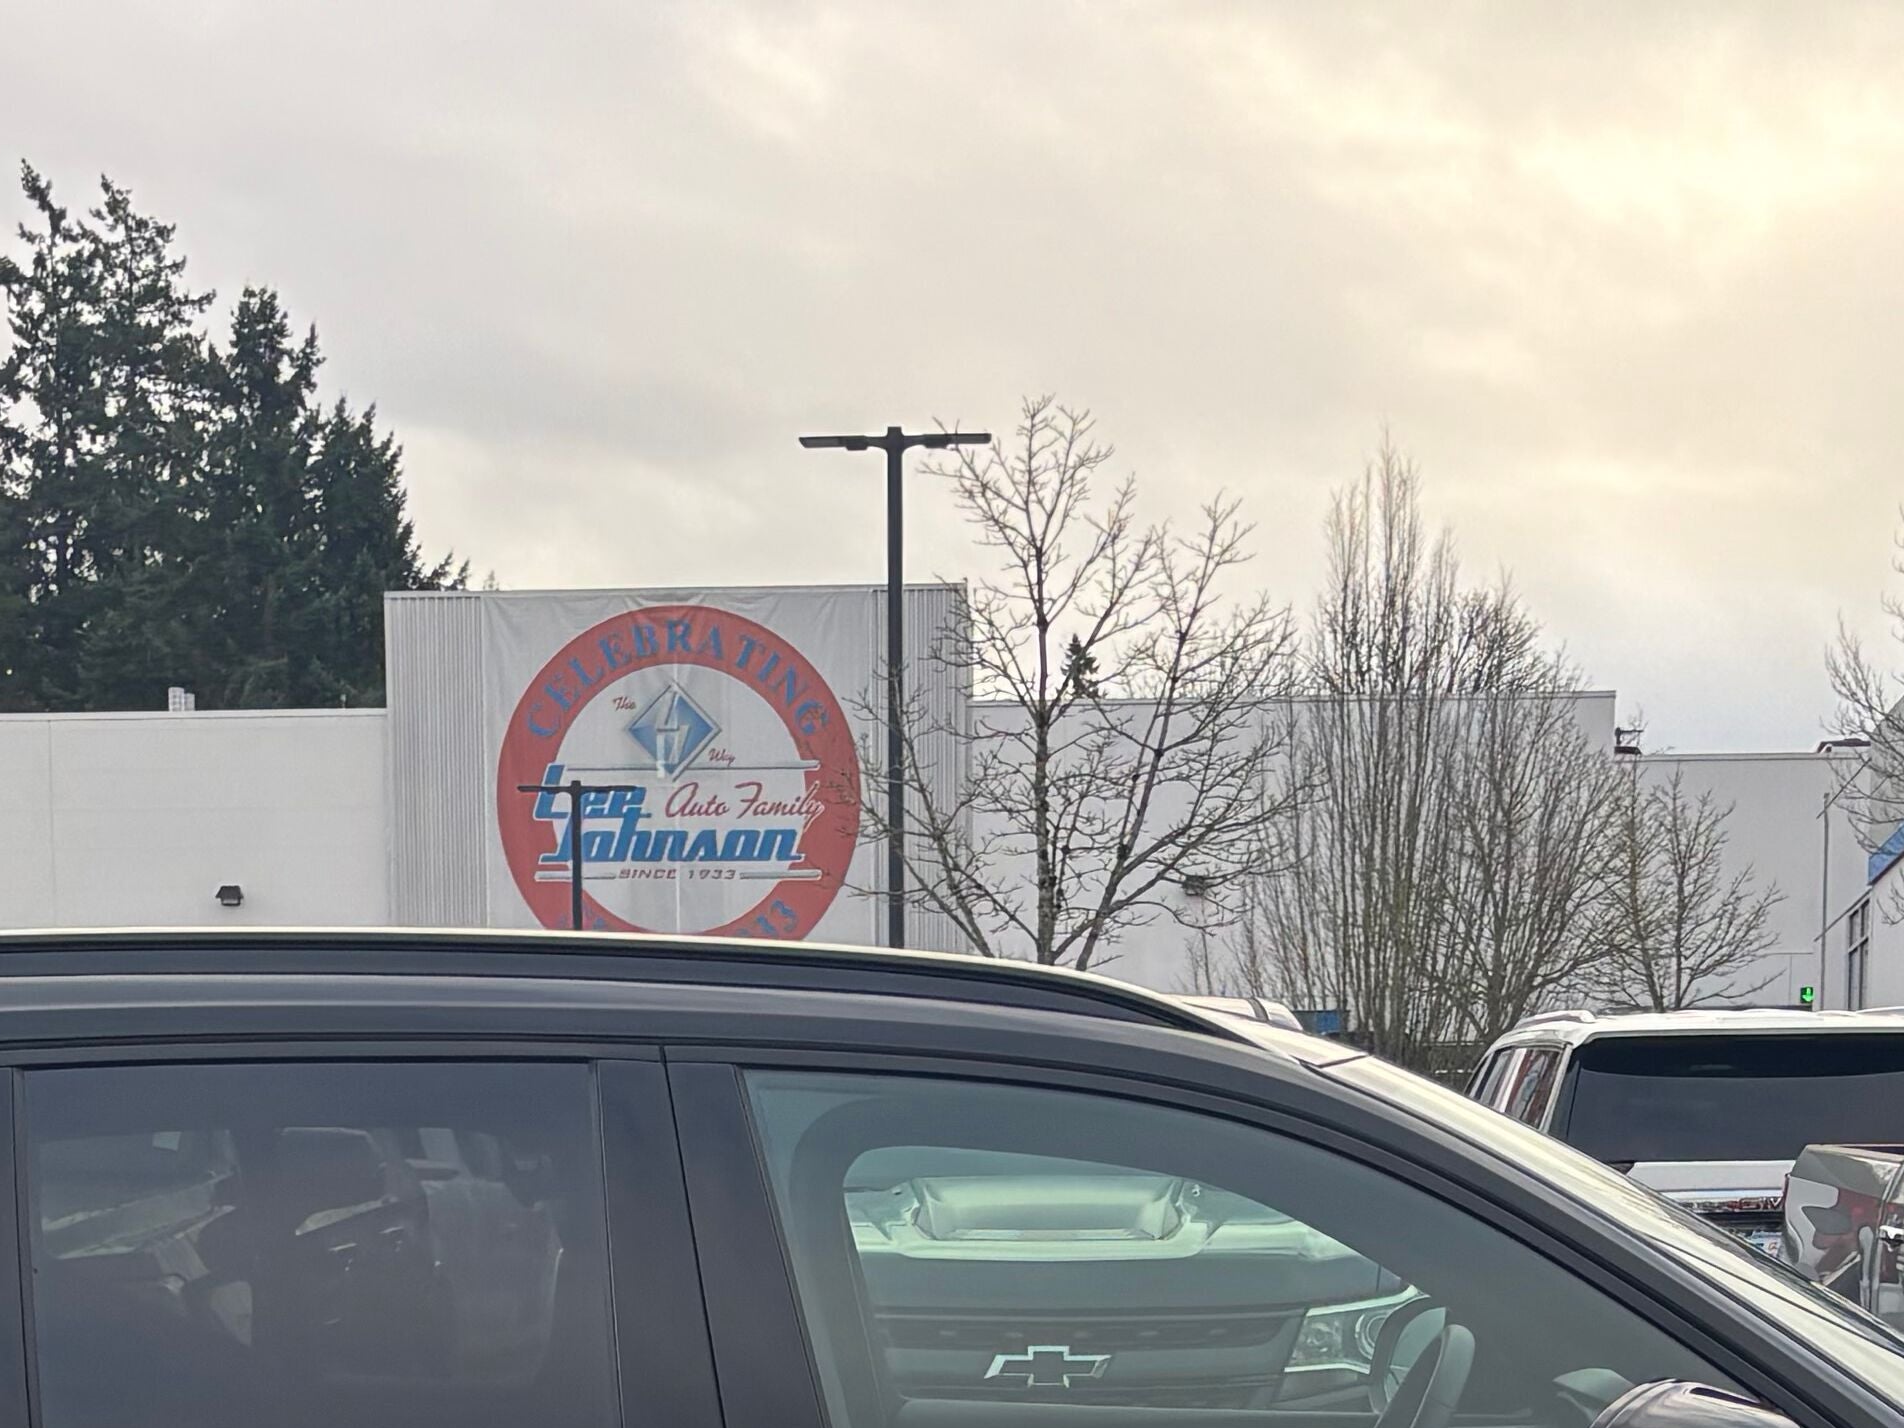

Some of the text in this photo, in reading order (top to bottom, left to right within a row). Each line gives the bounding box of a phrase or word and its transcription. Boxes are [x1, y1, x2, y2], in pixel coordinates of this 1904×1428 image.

[526, 619, 831, 738] CELEBRATING
[613, 697, 637, 710] The
[708, 749, 736, 767] Way
[534, 764, 823, 830] Lee Auto Family
[540, 810, 804, 862] Johnson
[619, 869, 737, 880] SINCE 1933
